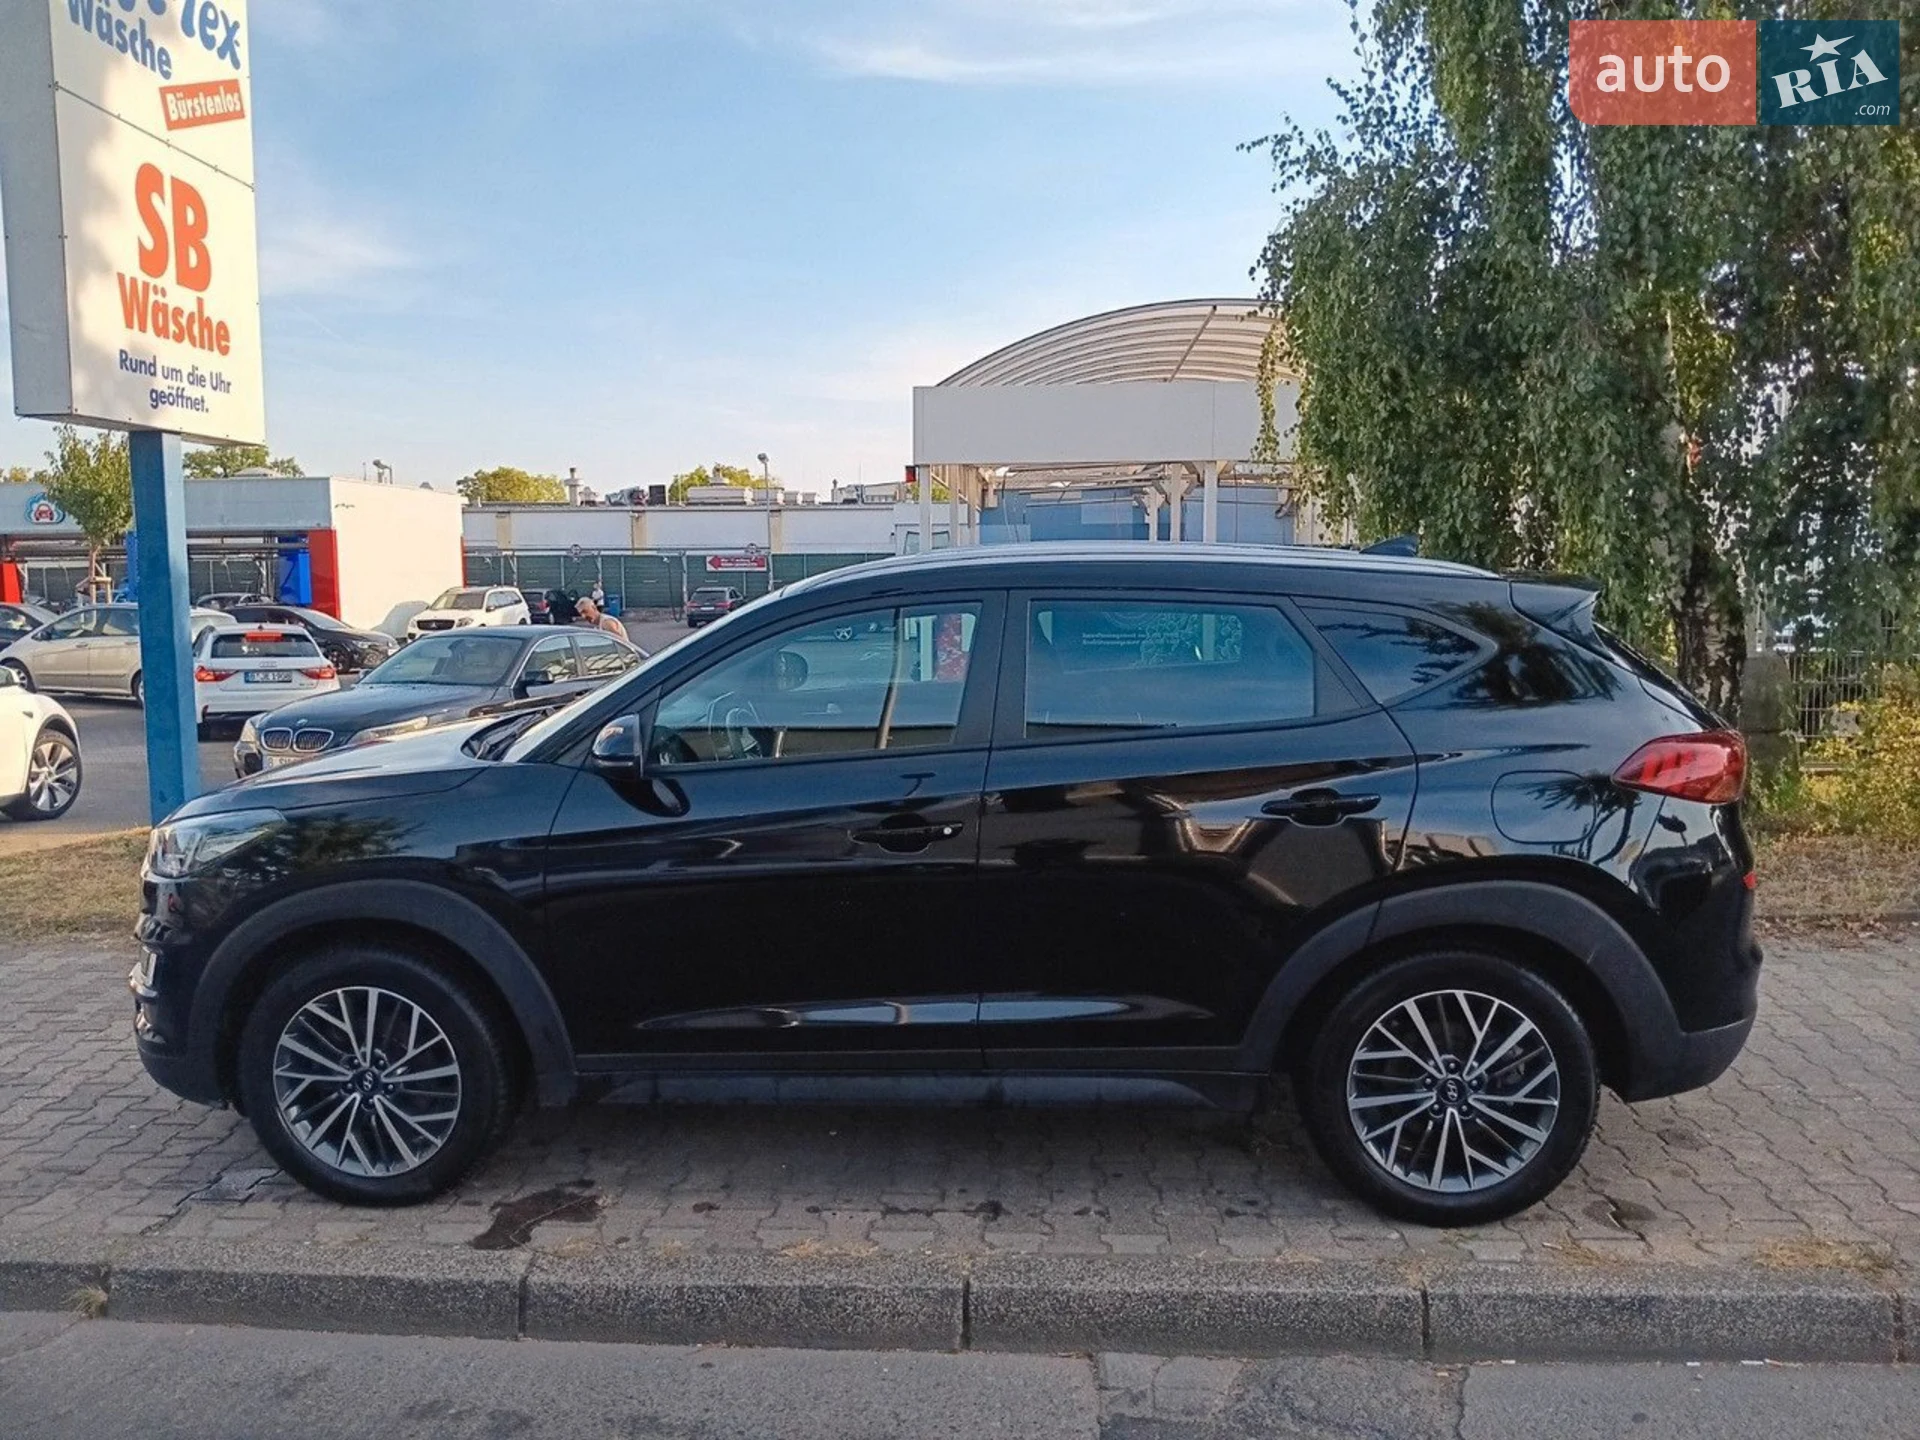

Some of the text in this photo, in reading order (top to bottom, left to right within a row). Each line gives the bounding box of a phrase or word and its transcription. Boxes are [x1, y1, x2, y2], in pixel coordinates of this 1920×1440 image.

[165, 86, 241, 121] Bürstenlos
[135, 162, 212, 292] SB
[117, 271, 230, 356] Wäsche
[119, 349, 232, 394] Rund um die Uhr
[149, 385, 209, 413] geöffnet.
